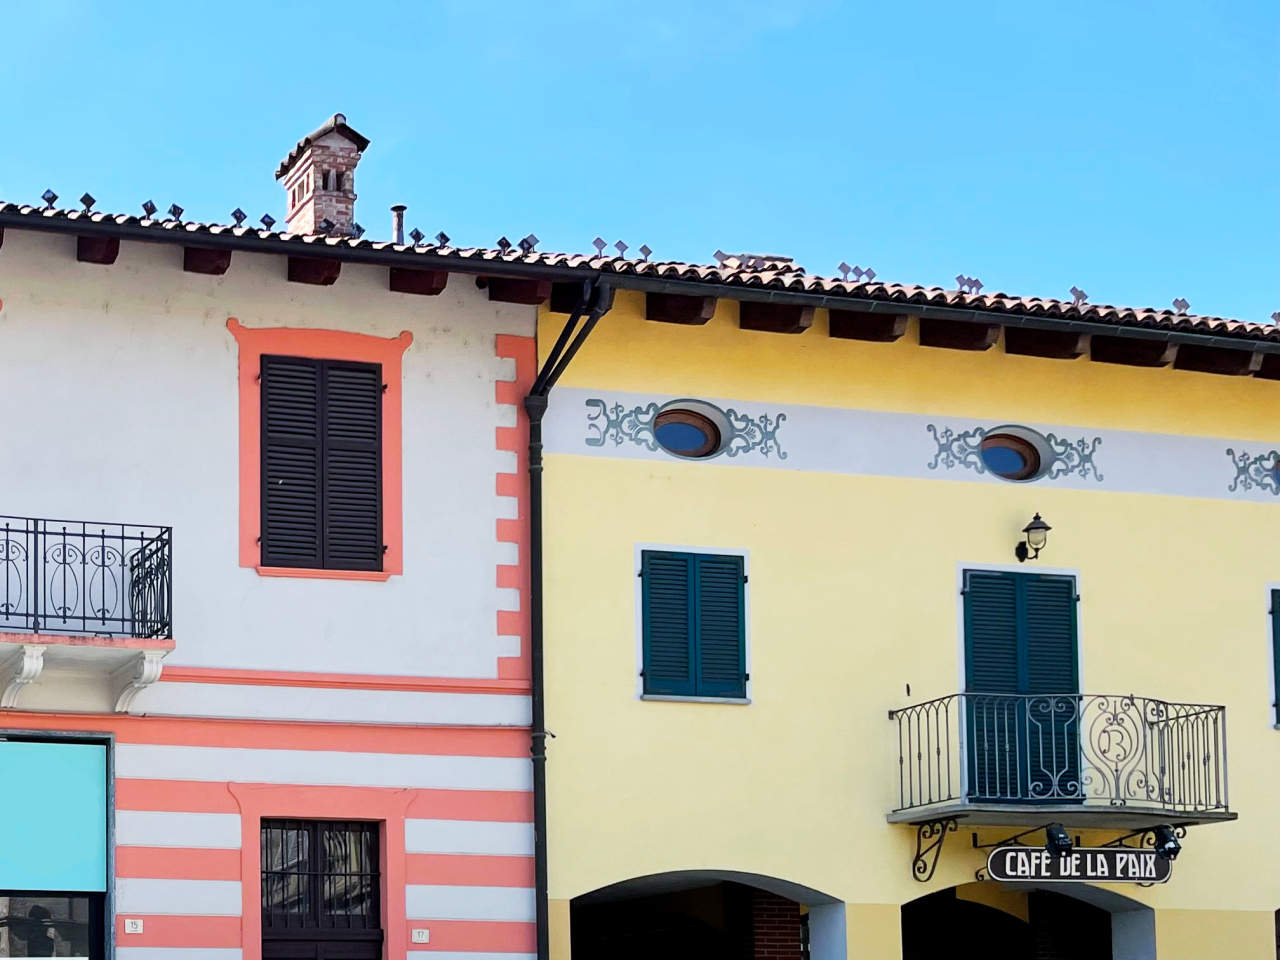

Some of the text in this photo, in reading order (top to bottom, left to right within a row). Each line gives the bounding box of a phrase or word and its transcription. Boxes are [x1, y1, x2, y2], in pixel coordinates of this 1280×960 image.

[1086, 853, 1109, 877] LA
[1116, 853, 1157, 878] PAIX
[130, 920, 139, 930] 15
[417, 930, 425, 939] 17
